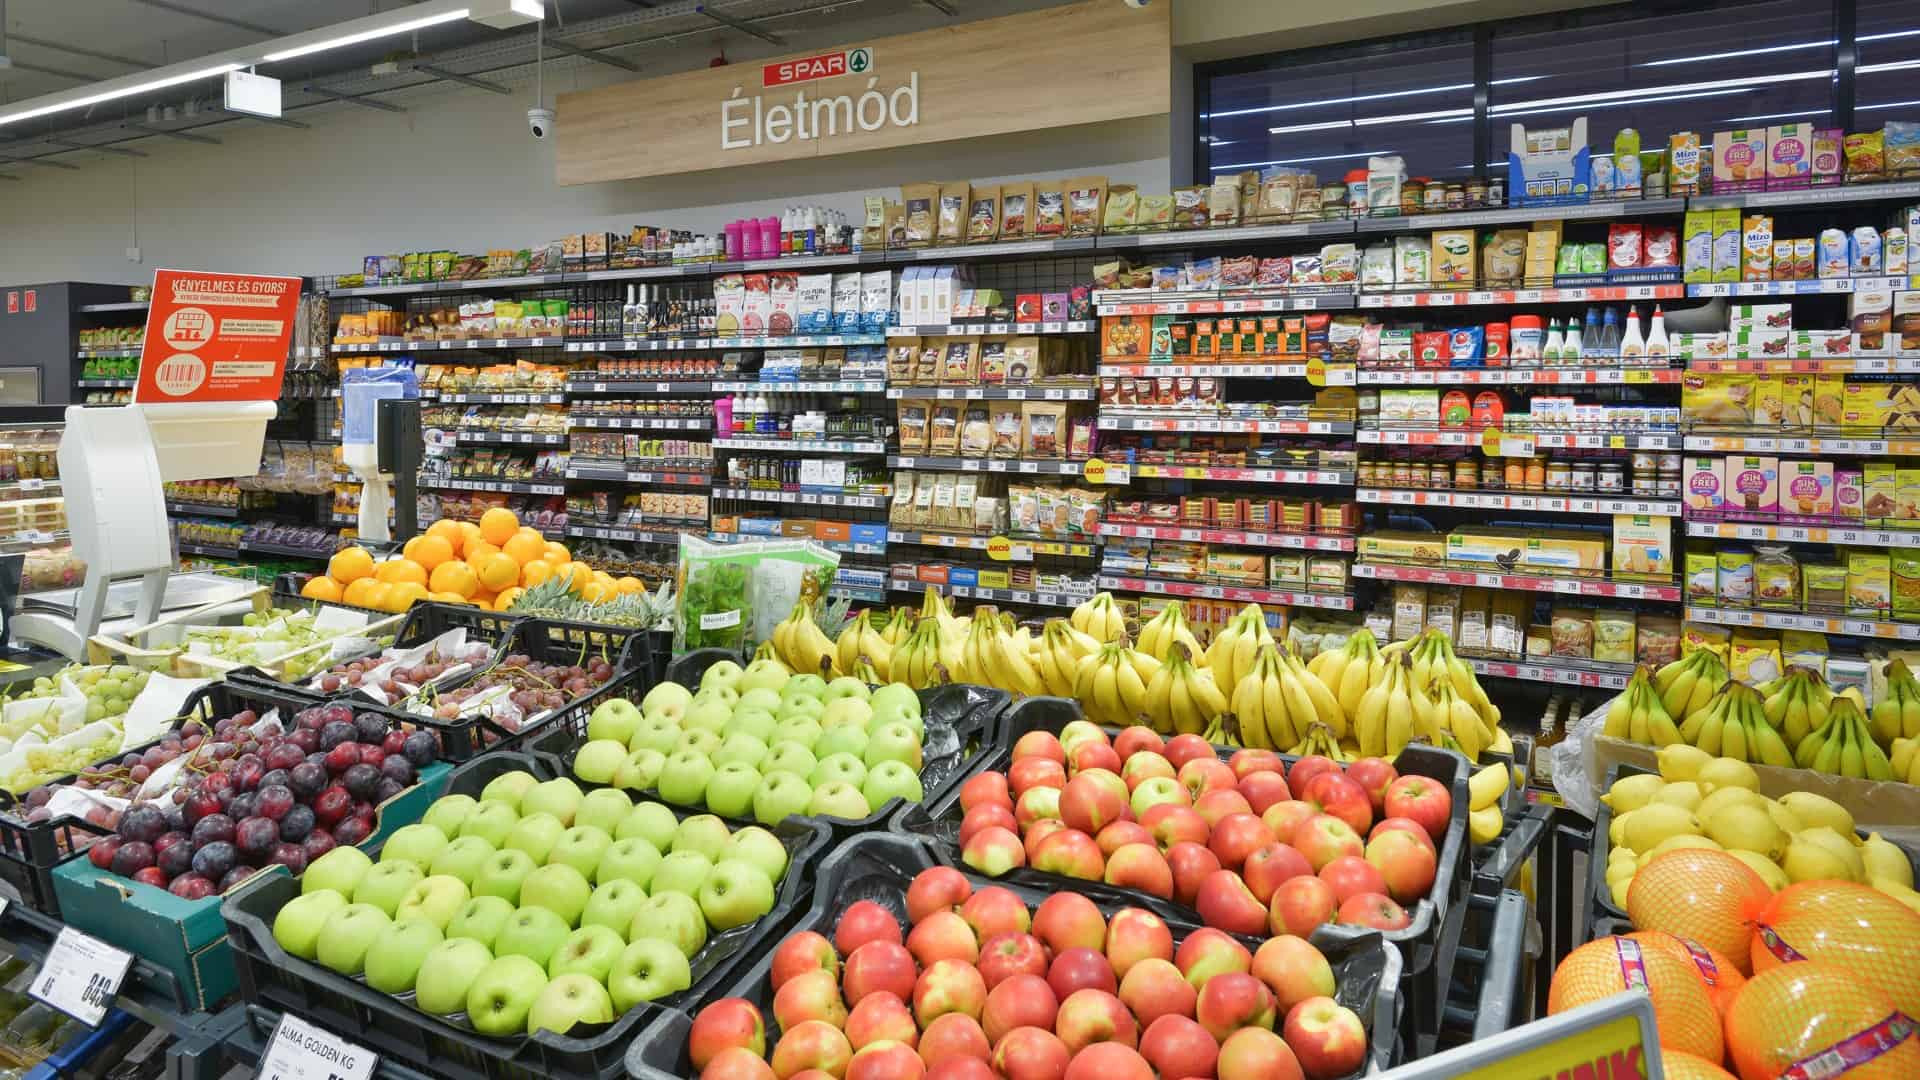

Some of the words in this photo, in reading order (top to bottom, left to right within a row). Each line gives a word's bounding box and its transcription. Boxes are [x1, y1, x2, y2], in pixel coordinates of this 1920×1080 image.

[779, 57, 844, 81] SPAR
[721, 71, 919, 150] Életmód
[1674, 150, 1697, 160] Mizo
[1746, 233, 1770, 242] Mizo
[171, 277, 234, 292] KÉNYELMES
[237, 279, 250, 293] ÉS
[252, 281, 288, 294] GYORS!
[1742, 474, 1761, 482] SIN
[988, 543, 1010, 552] AKCIÓ
[280, 1025, 303, 1046] ALMA
[304, 1037, 340, 1063] GOLDEN
[341, 1055, 355, 1070] KG
